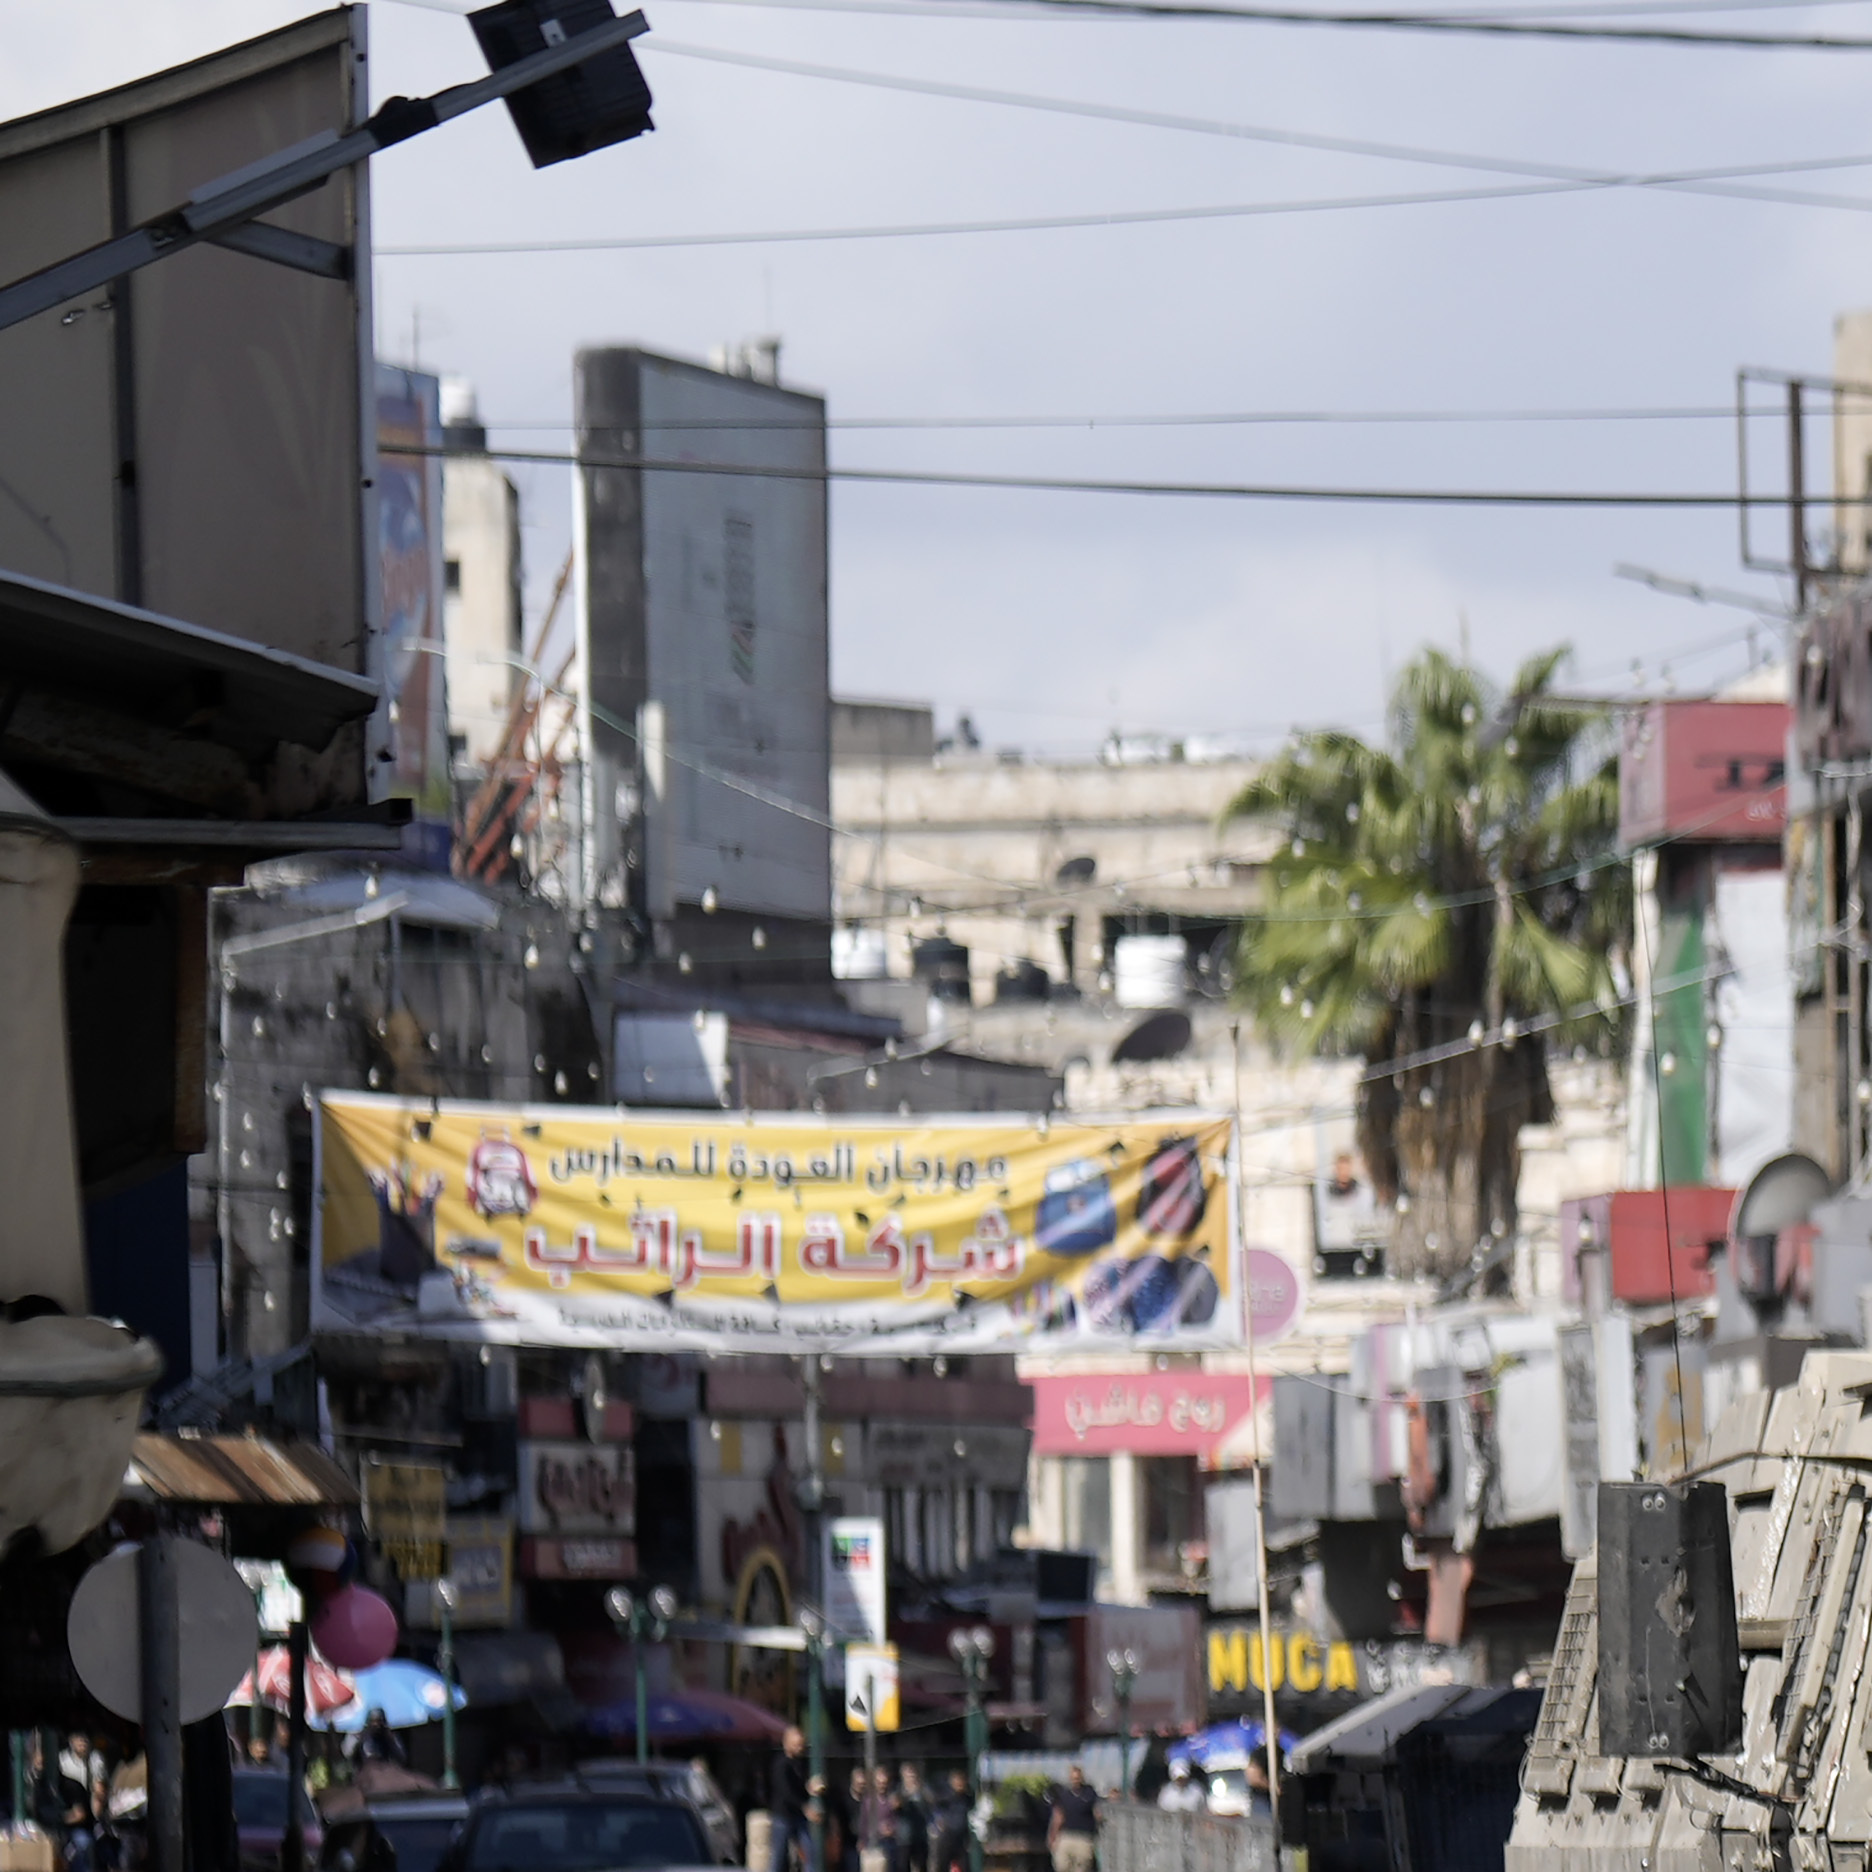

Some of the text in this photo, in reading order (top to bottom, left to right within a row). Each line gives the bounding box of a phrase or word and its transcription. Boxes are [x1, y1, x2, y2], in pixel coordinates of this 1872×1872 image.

[549, 1136, 1008, 1192] مهرجان العودة للمدارس
[801, 1204, 1026, 1296] شركة
[1207, 1629, 1358, 1693] MUCA
